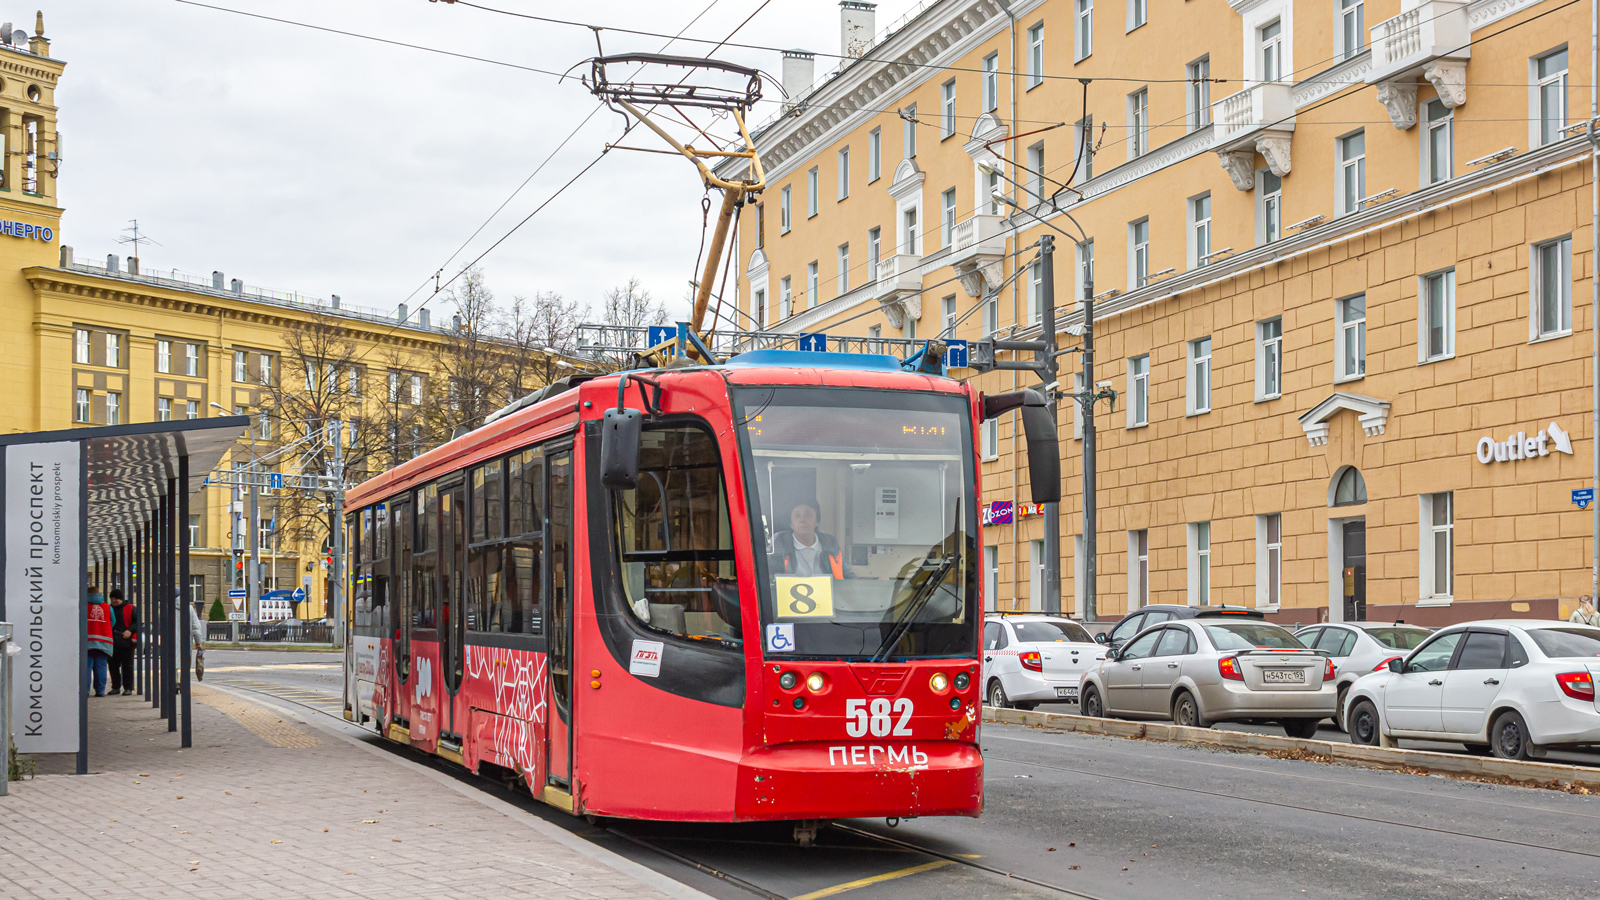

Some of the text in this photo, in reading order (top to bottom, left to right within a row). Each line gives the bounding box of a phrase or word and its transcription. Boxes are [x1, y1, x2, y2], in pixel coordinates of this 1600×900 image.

[0, 219, 53, 241] НЕРГО
[1476, 429, 1550, 464] Outlet
[52, 461, 63, 565] Komsomolskiy prospekt
[24, 461, 49, 737] Комсомольский проспект
[789, 583, 817, 615] 8
[845, 697, 914, 738] 582
[828, 745, 929, 766] ПЕРМЬ
